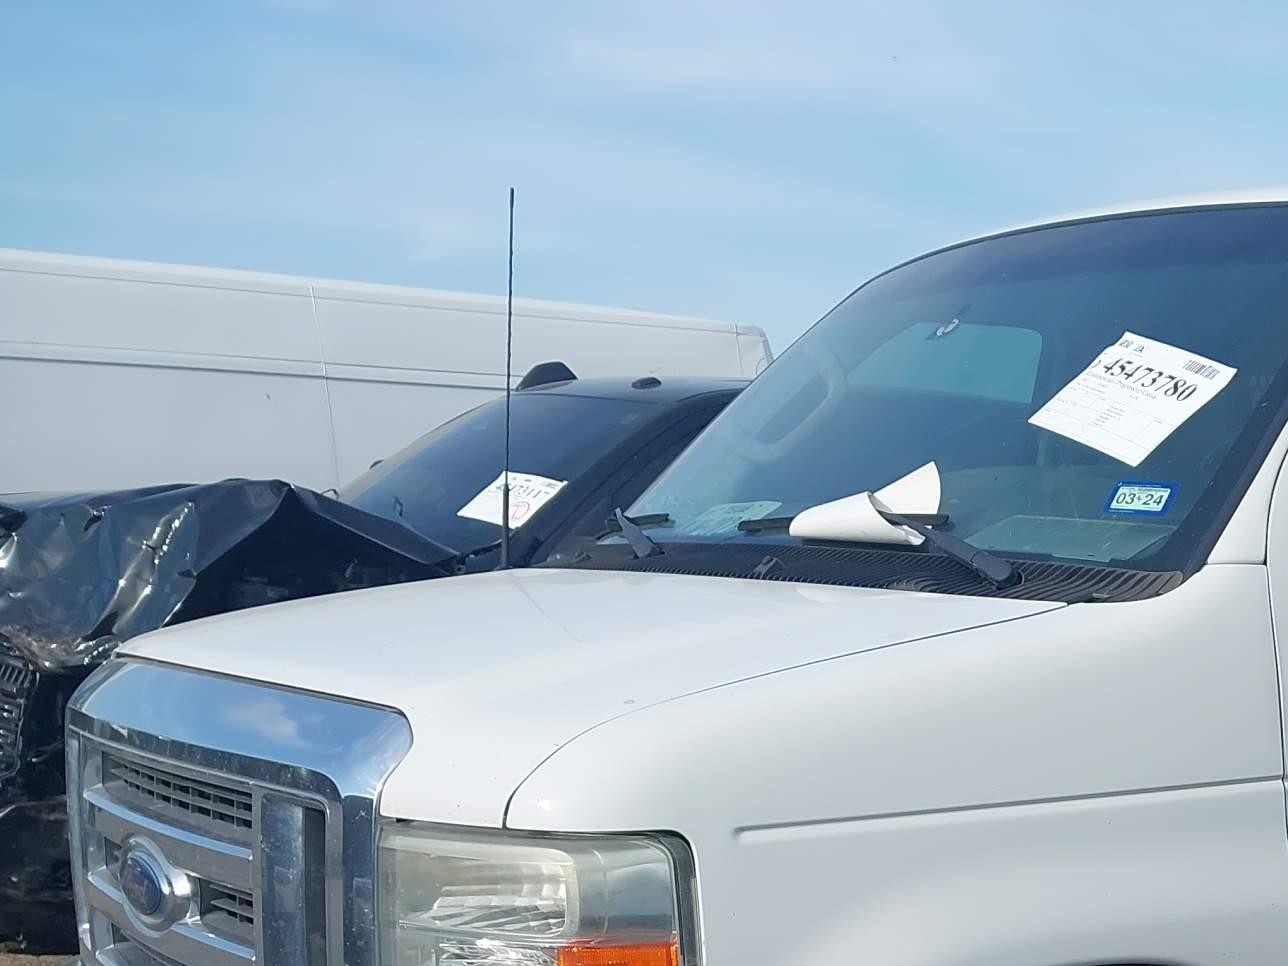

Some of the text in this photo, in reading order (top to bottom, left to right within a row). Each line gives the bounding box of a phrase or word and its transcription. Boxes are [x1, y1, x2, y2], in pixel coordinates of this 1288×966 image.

[1103, 357, 1198, 402] 45473780
[1115, 492, 1164, 506] 03 24
